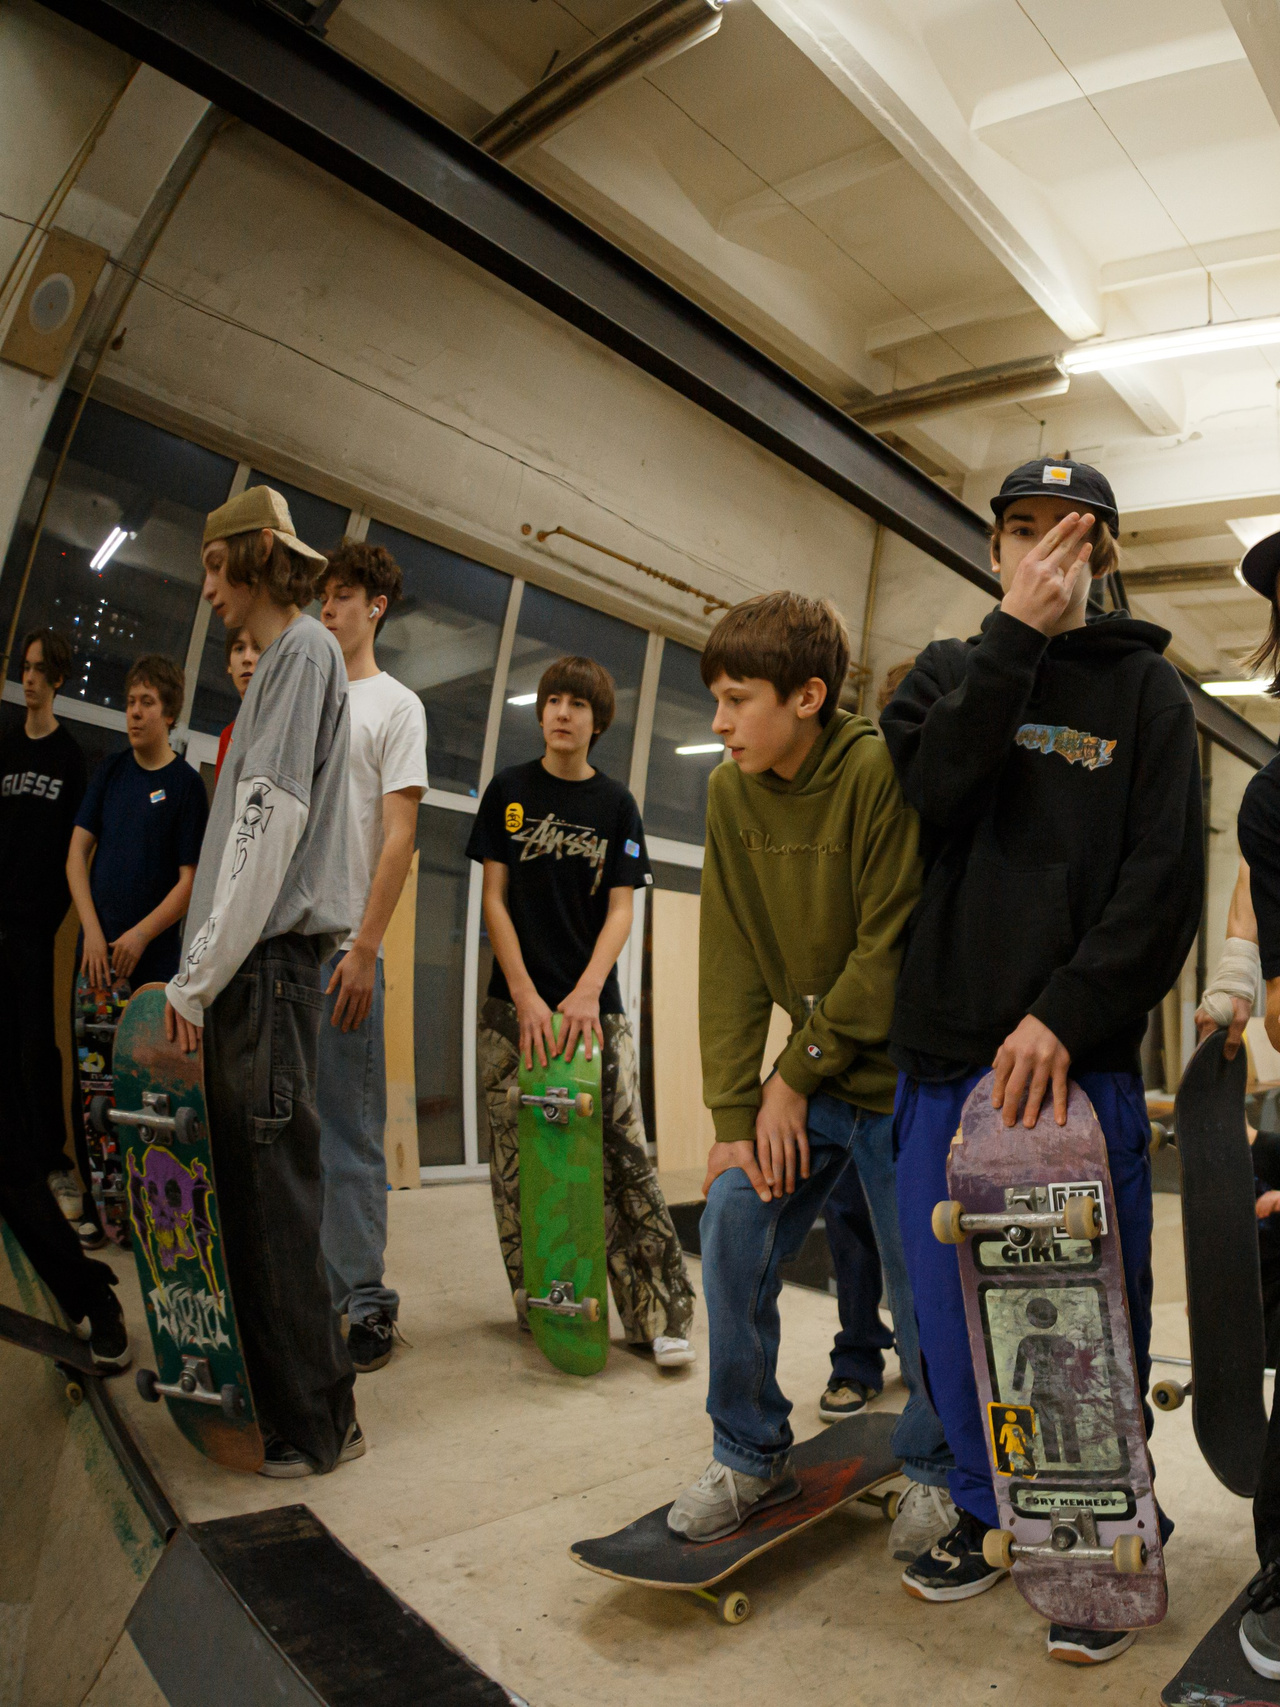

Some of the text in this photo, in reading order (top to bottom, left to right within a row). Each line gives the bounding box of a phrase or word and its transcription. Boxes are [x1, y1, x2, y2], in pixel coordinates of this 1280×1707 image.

[1, 771, 64, 800] GUESS
[1001, 1242, 1070, 1263] GIRL
[1060, 1498, 1118, 1507] KENNEDY
